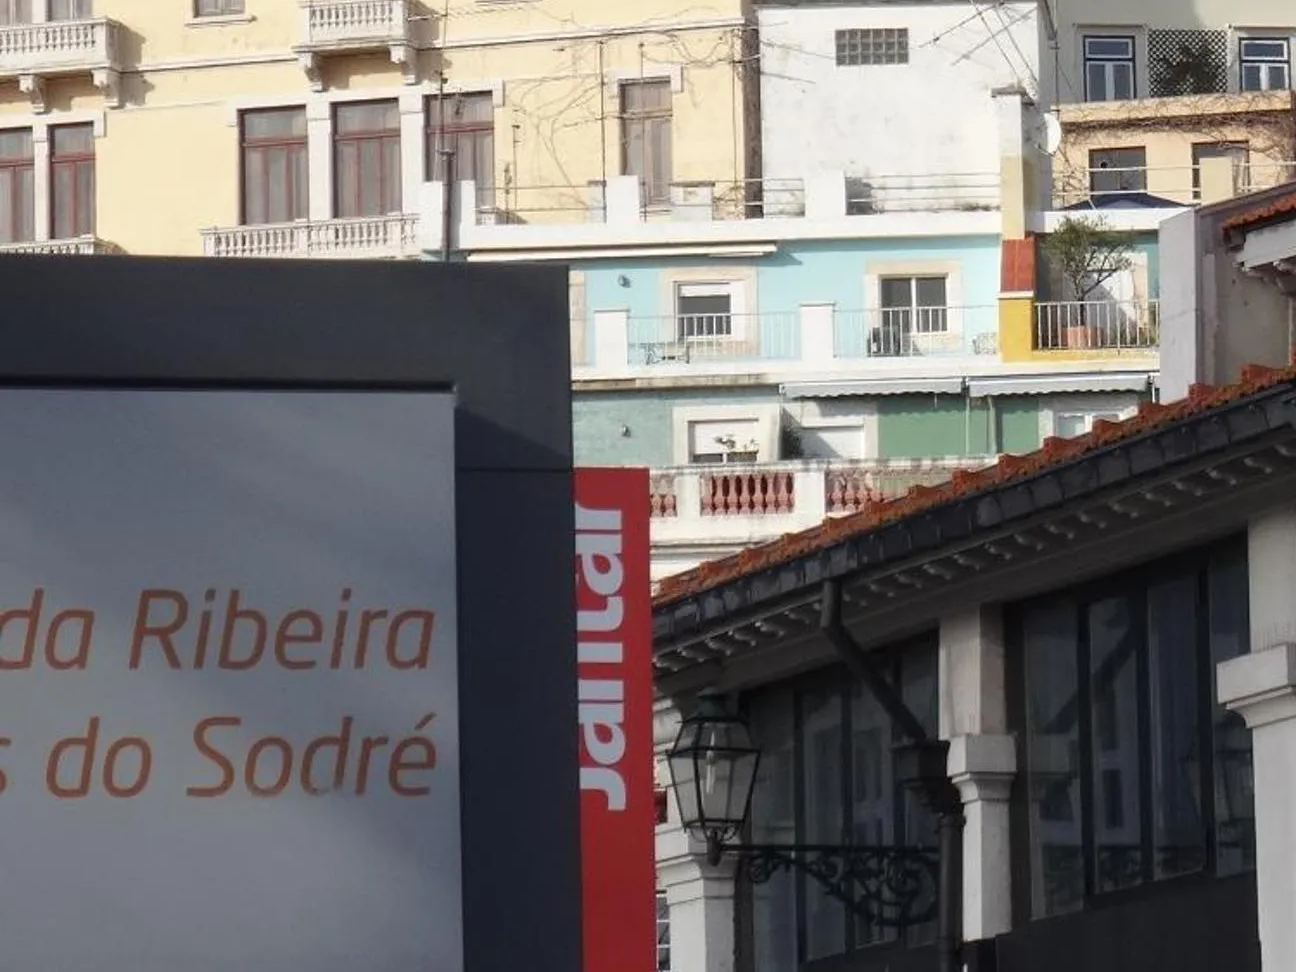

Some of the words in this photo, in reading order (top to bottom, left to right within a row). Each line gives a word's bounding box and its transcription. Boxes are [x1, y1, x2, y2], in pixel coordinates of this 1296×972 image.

[0, 588, 95, 670] da
[128, 588, 436, 670] Ribeira
[45, 716, 152, 799] do
[186, 712, 437, 798] Sodré
